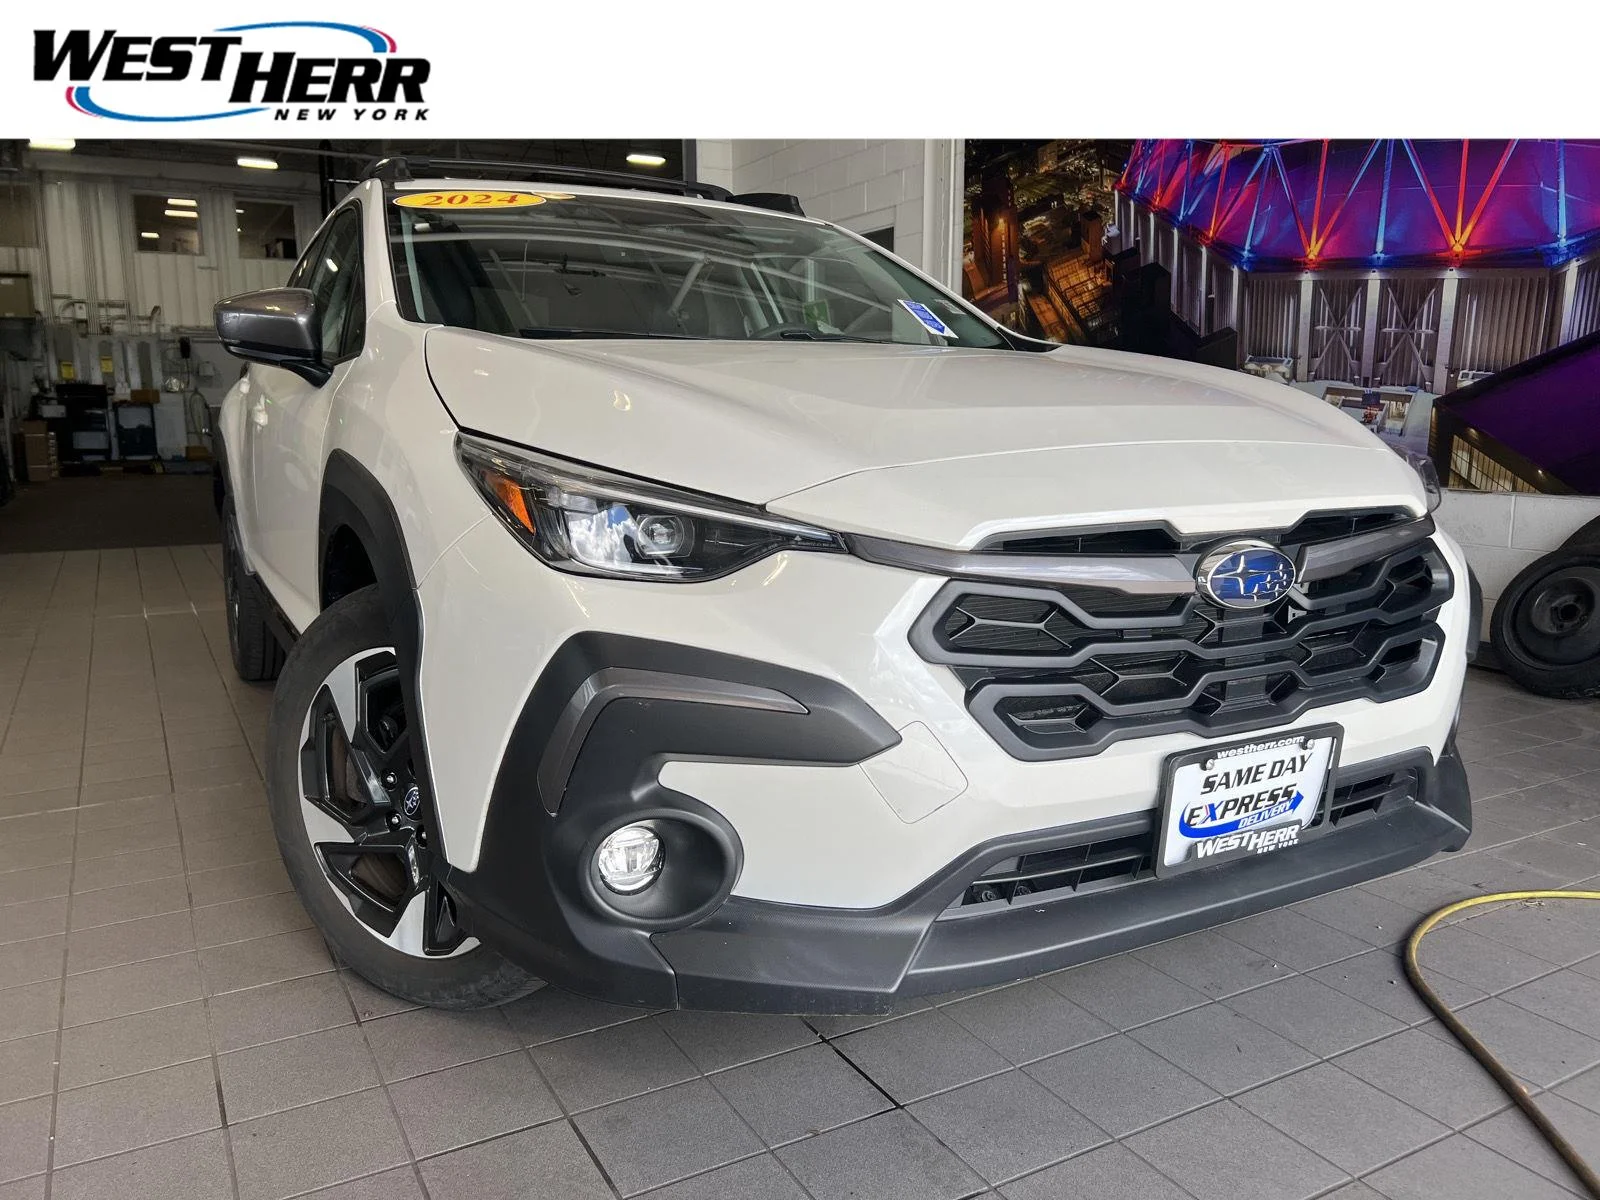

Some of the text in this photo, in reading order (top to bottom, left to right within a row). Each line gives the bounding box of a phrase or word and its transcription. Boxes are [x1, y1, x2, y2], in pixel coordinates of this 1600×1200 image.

[423, 194, 519, 206] 2024
[1217, 736, 1304, 759] westherr.com
[1201, 752, 1313, 795] SAME DAY
[1187, 783, 1298, 826] EXPRESS
[1238, 800, 1293, 829] DELIVERY
[1257, 838, 1299, 854] NEW YORK
